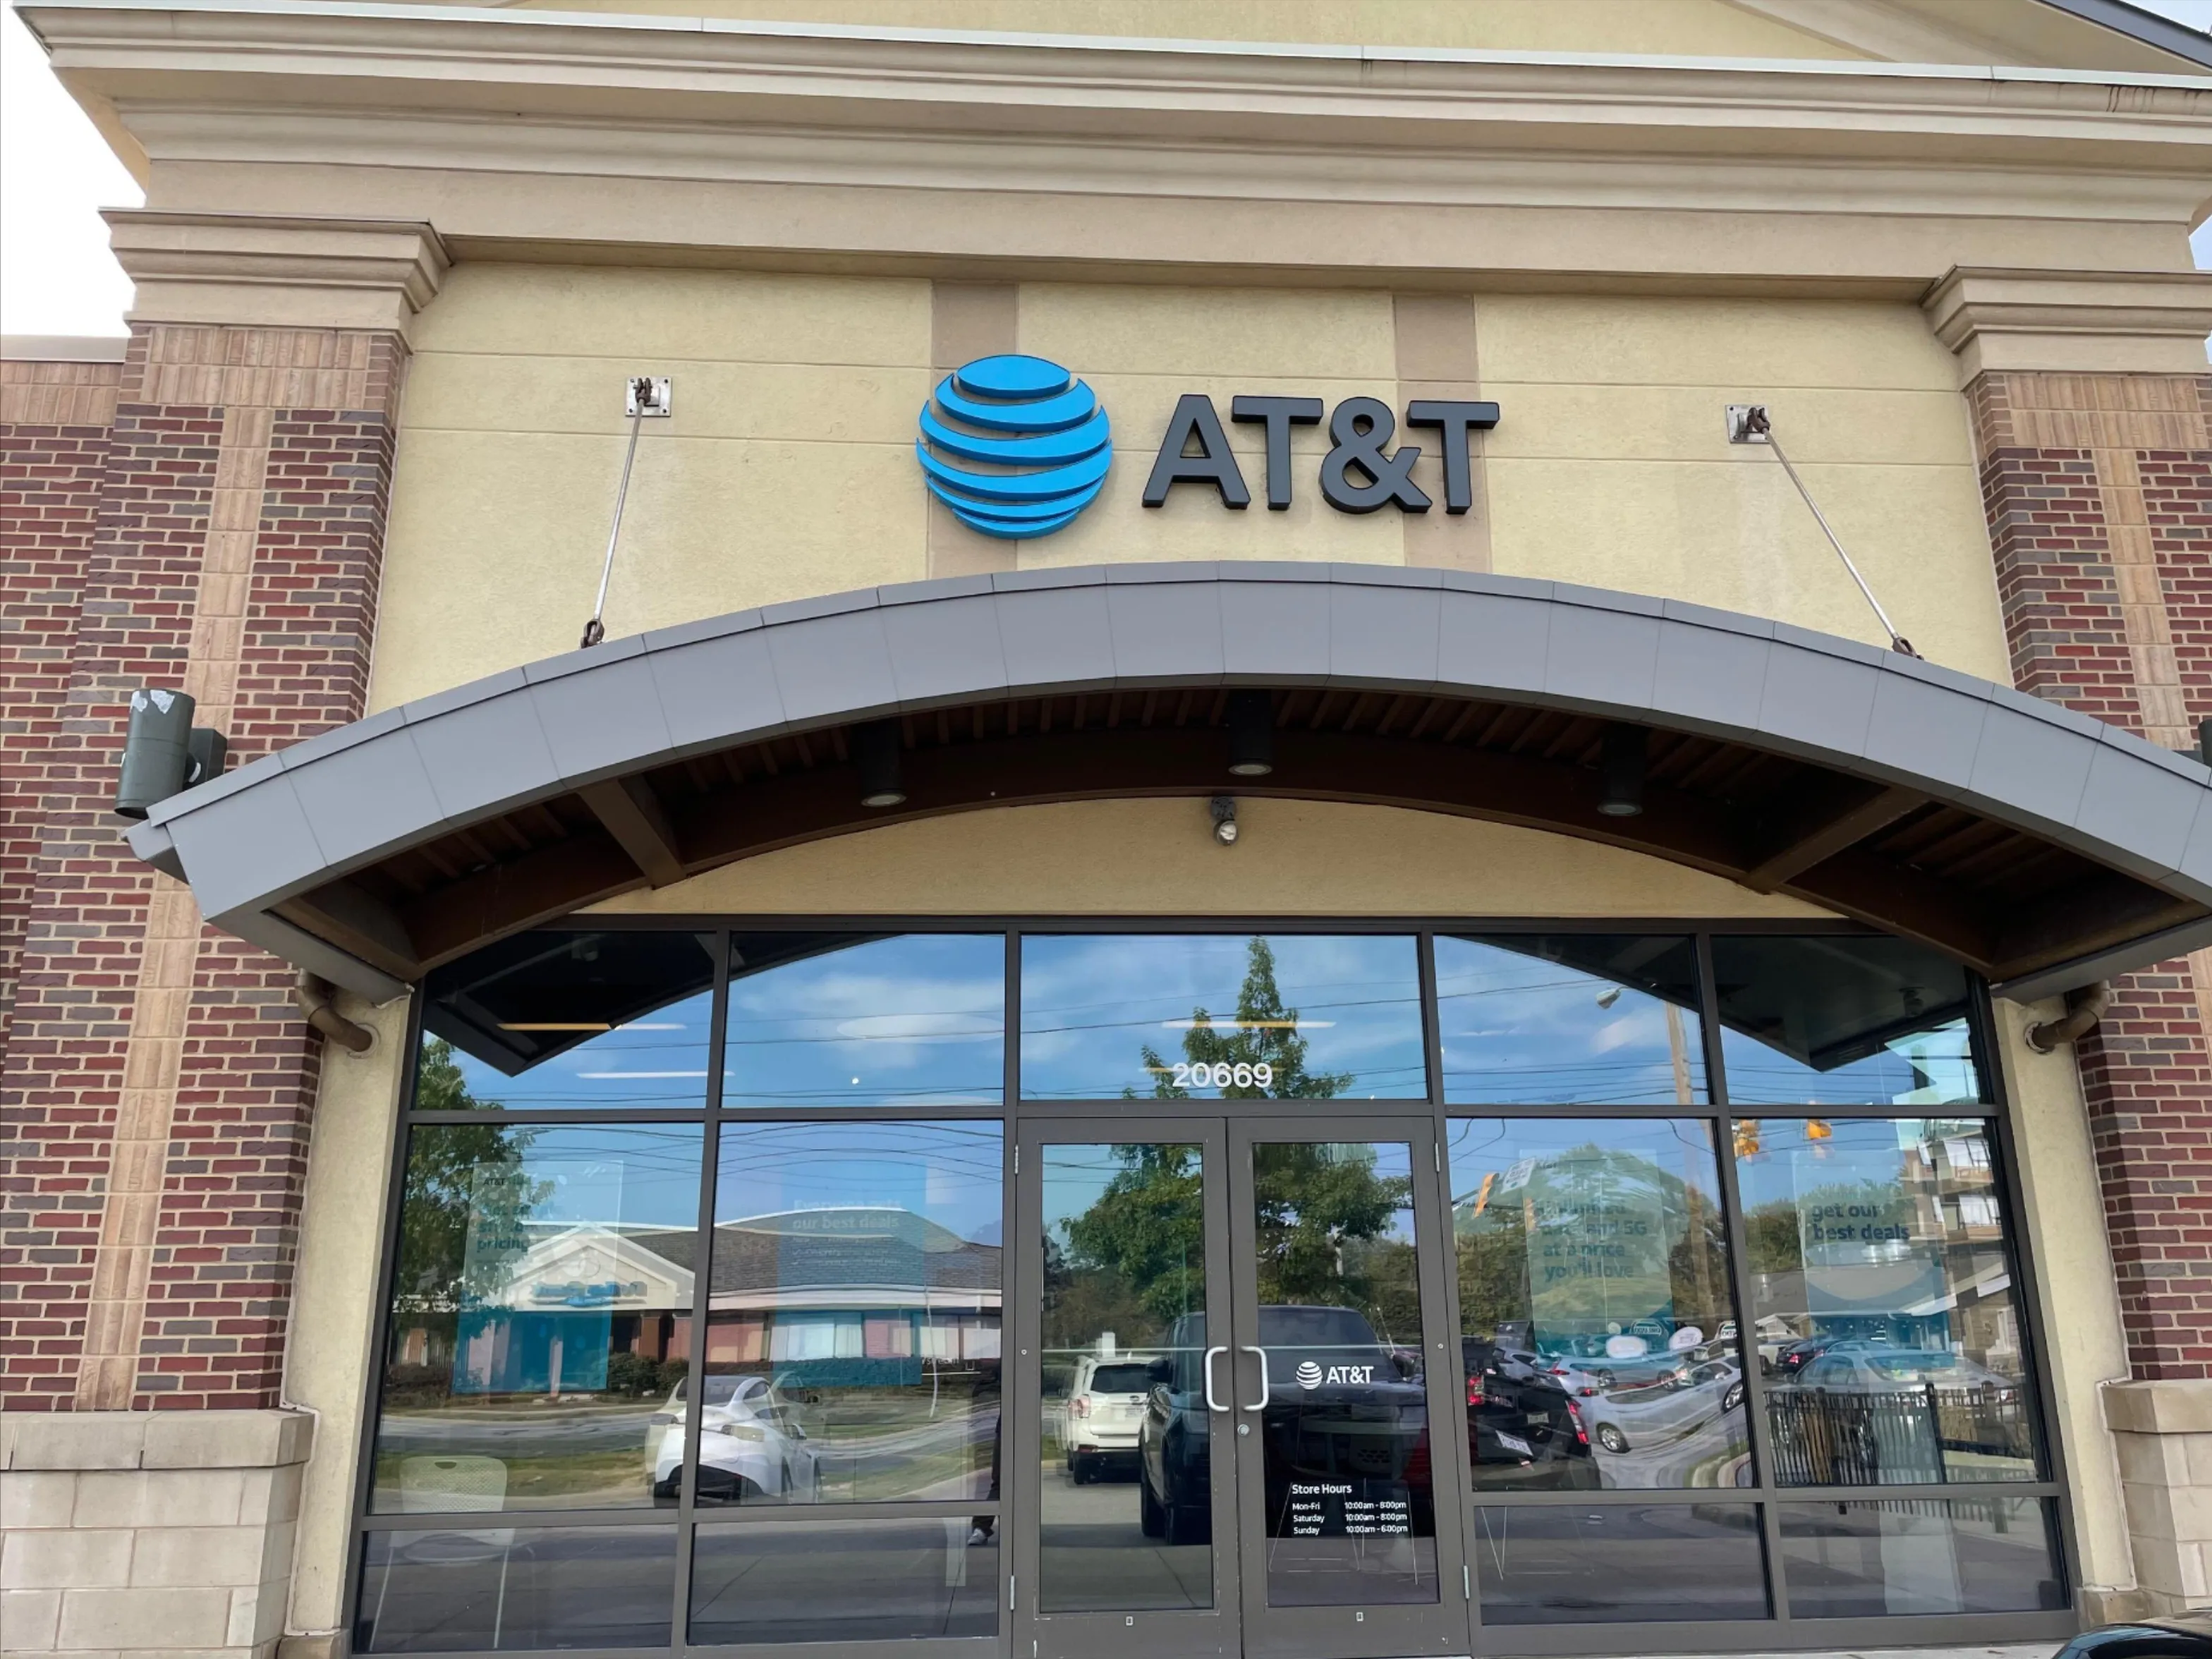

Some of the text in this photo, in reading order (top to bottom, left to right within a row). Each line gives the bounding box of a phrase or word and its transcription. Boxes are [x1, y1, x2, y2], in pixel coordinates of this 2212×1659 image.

[1142, 394, 1500, 515] AT&T
[1172, 1062, 1272, 1088] 20669
[1812, 1203, 1878, 1222] get our
[793, 1218, 818, 1229] our
[822, 1214, 855, 1229] best
[1624, 1220, 1648, 1235] 5G
[1813, 1223, 1910, 1240] best deals
[477, 1237, 529, 1253] pricing
[1326, 1366, 1375, 1384] AT&T
[1292, 1484, 1352, 1494] Store Hours
[1292, 1502, 1320, 1510] Mon-Fri
[1380, 1502, 1406, 1510] 8:00pm
[1294, 1515, 1325, 1524] Saturday
[1380, 1514, 1407, 1522] 8:00pm
[1294, 1527, 1320, 1536] Sunday
[1381, 1525, 1408, 1534] 6:00pm
